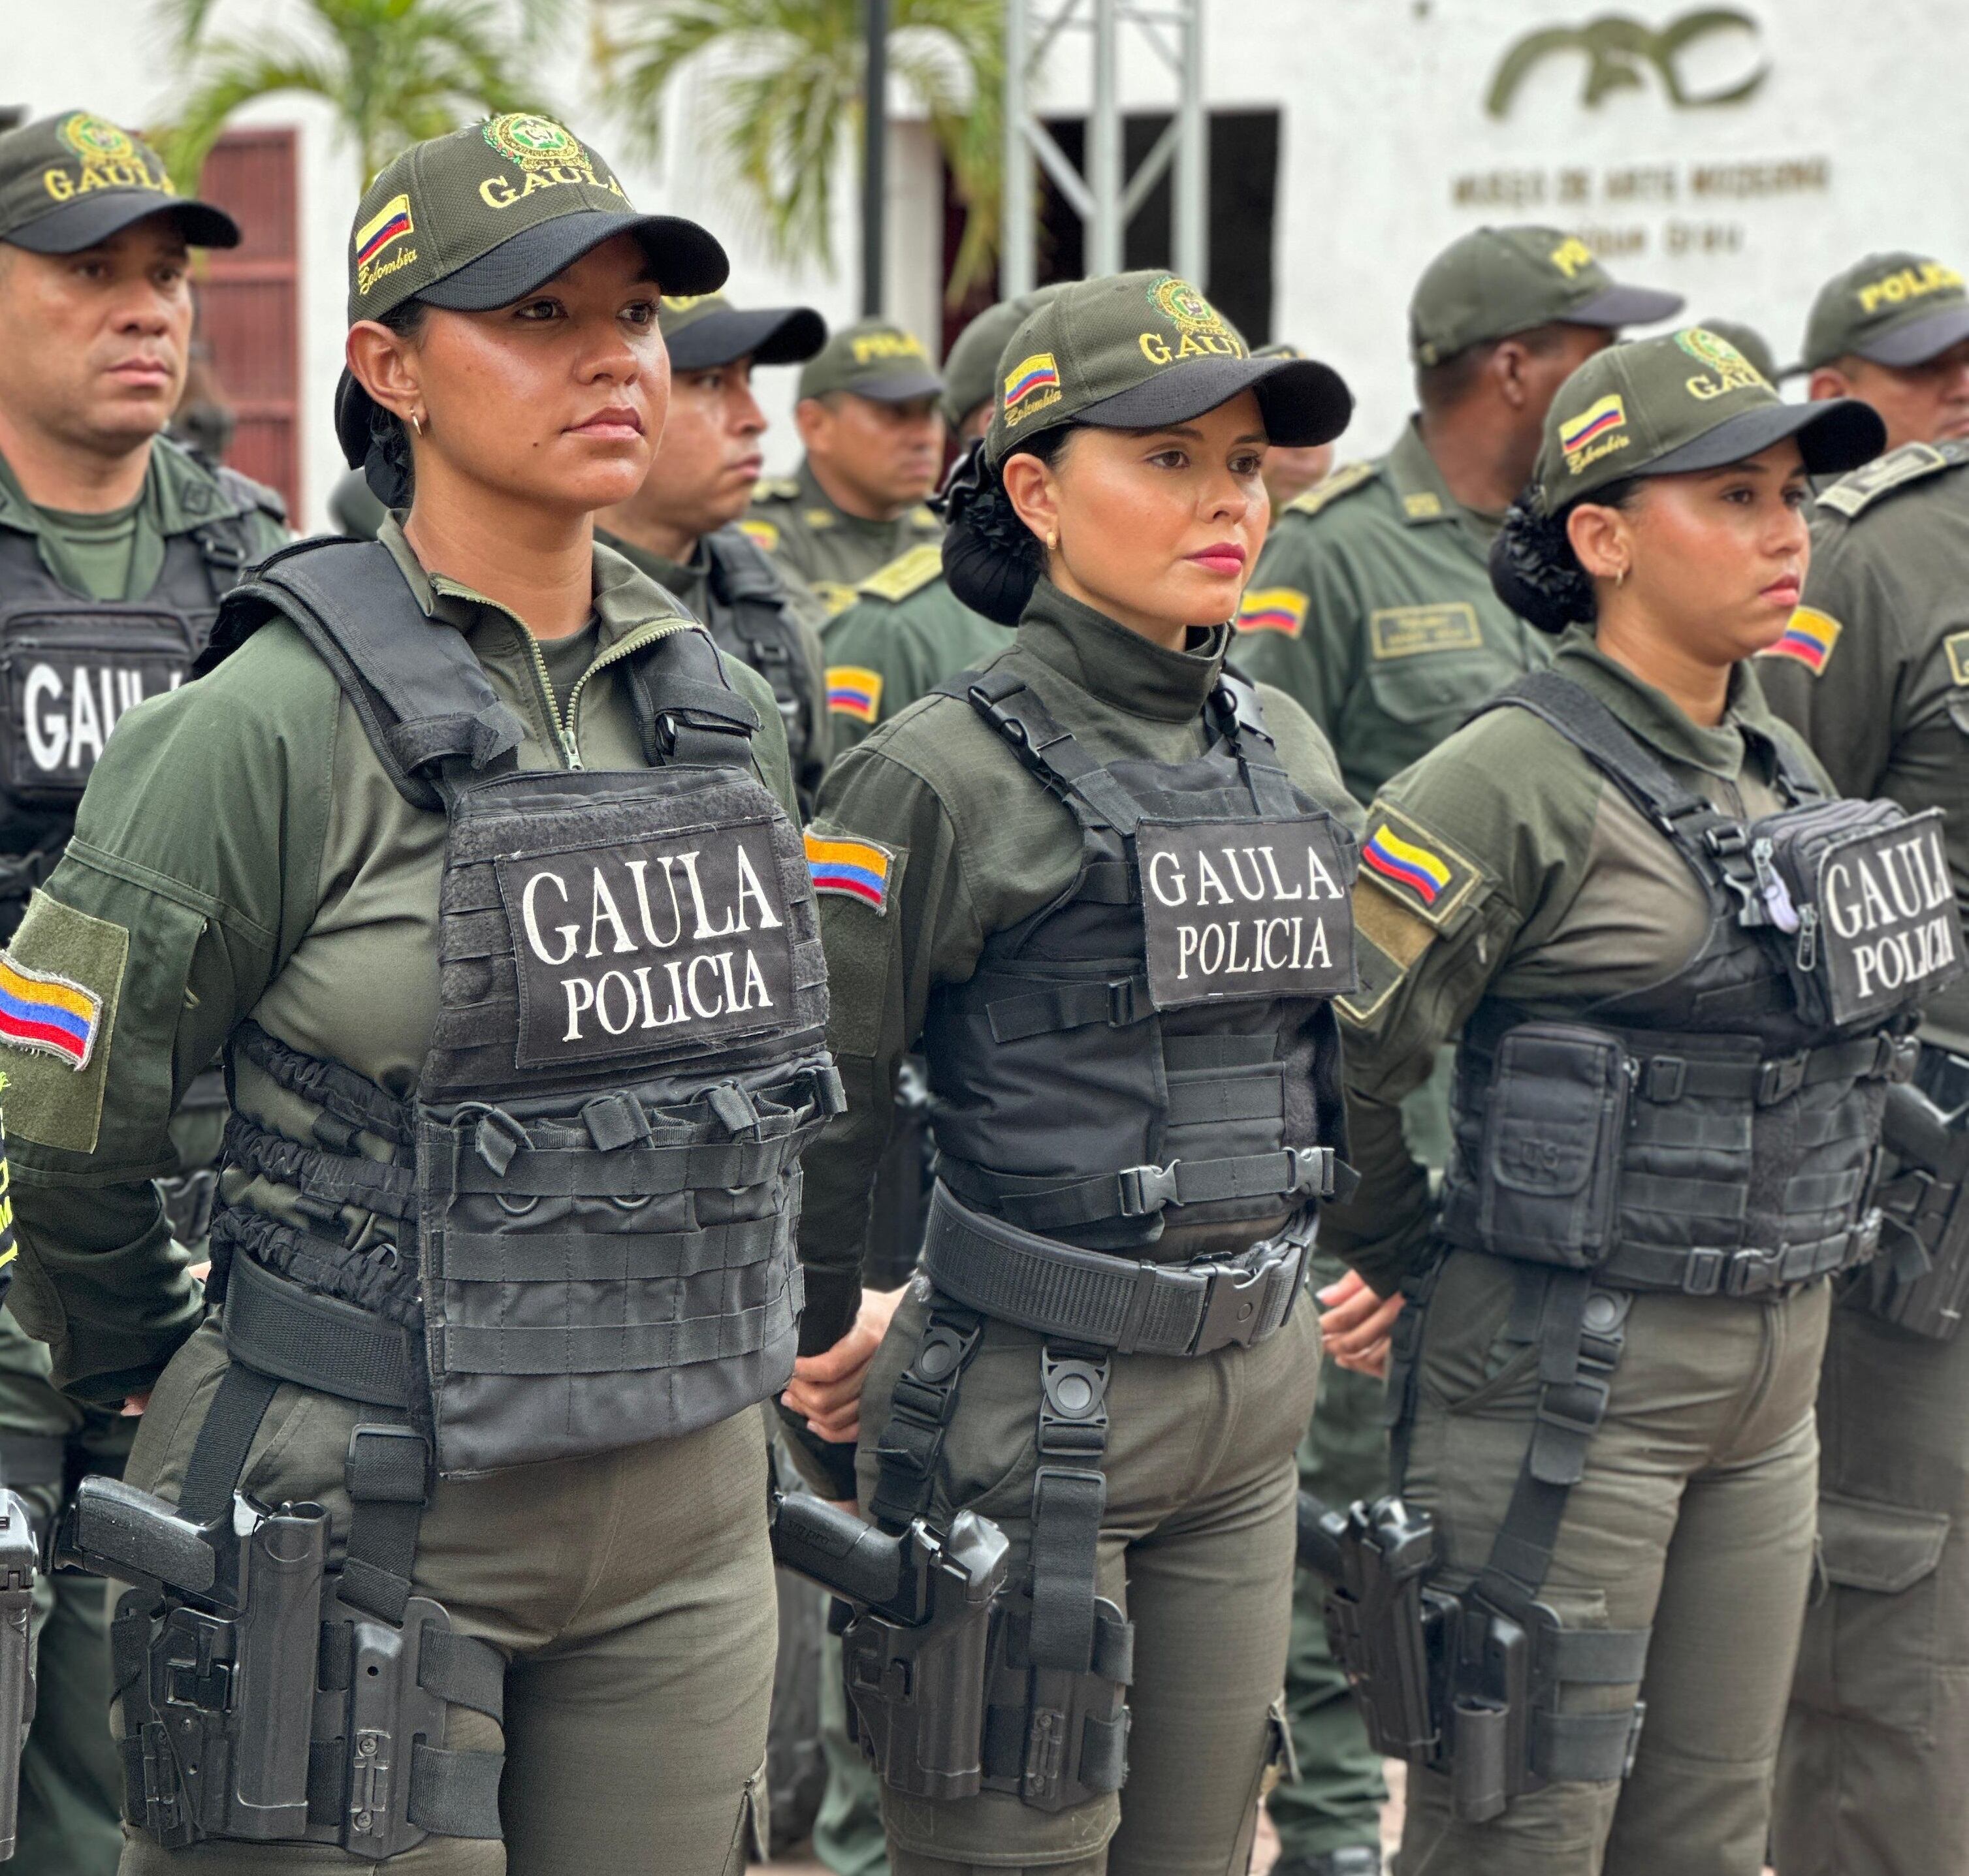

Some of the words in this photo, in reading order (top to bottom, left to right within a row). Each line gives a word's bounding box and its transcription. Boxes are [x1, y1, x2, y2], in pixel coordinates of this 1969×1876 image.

[522, 846, 783, 966] GAULA
[1149, 846, 1344, 907] GAULA
[1177, 916, 1333, 980] POLICIA
[561, 949, 774, 1042] POLICIA
